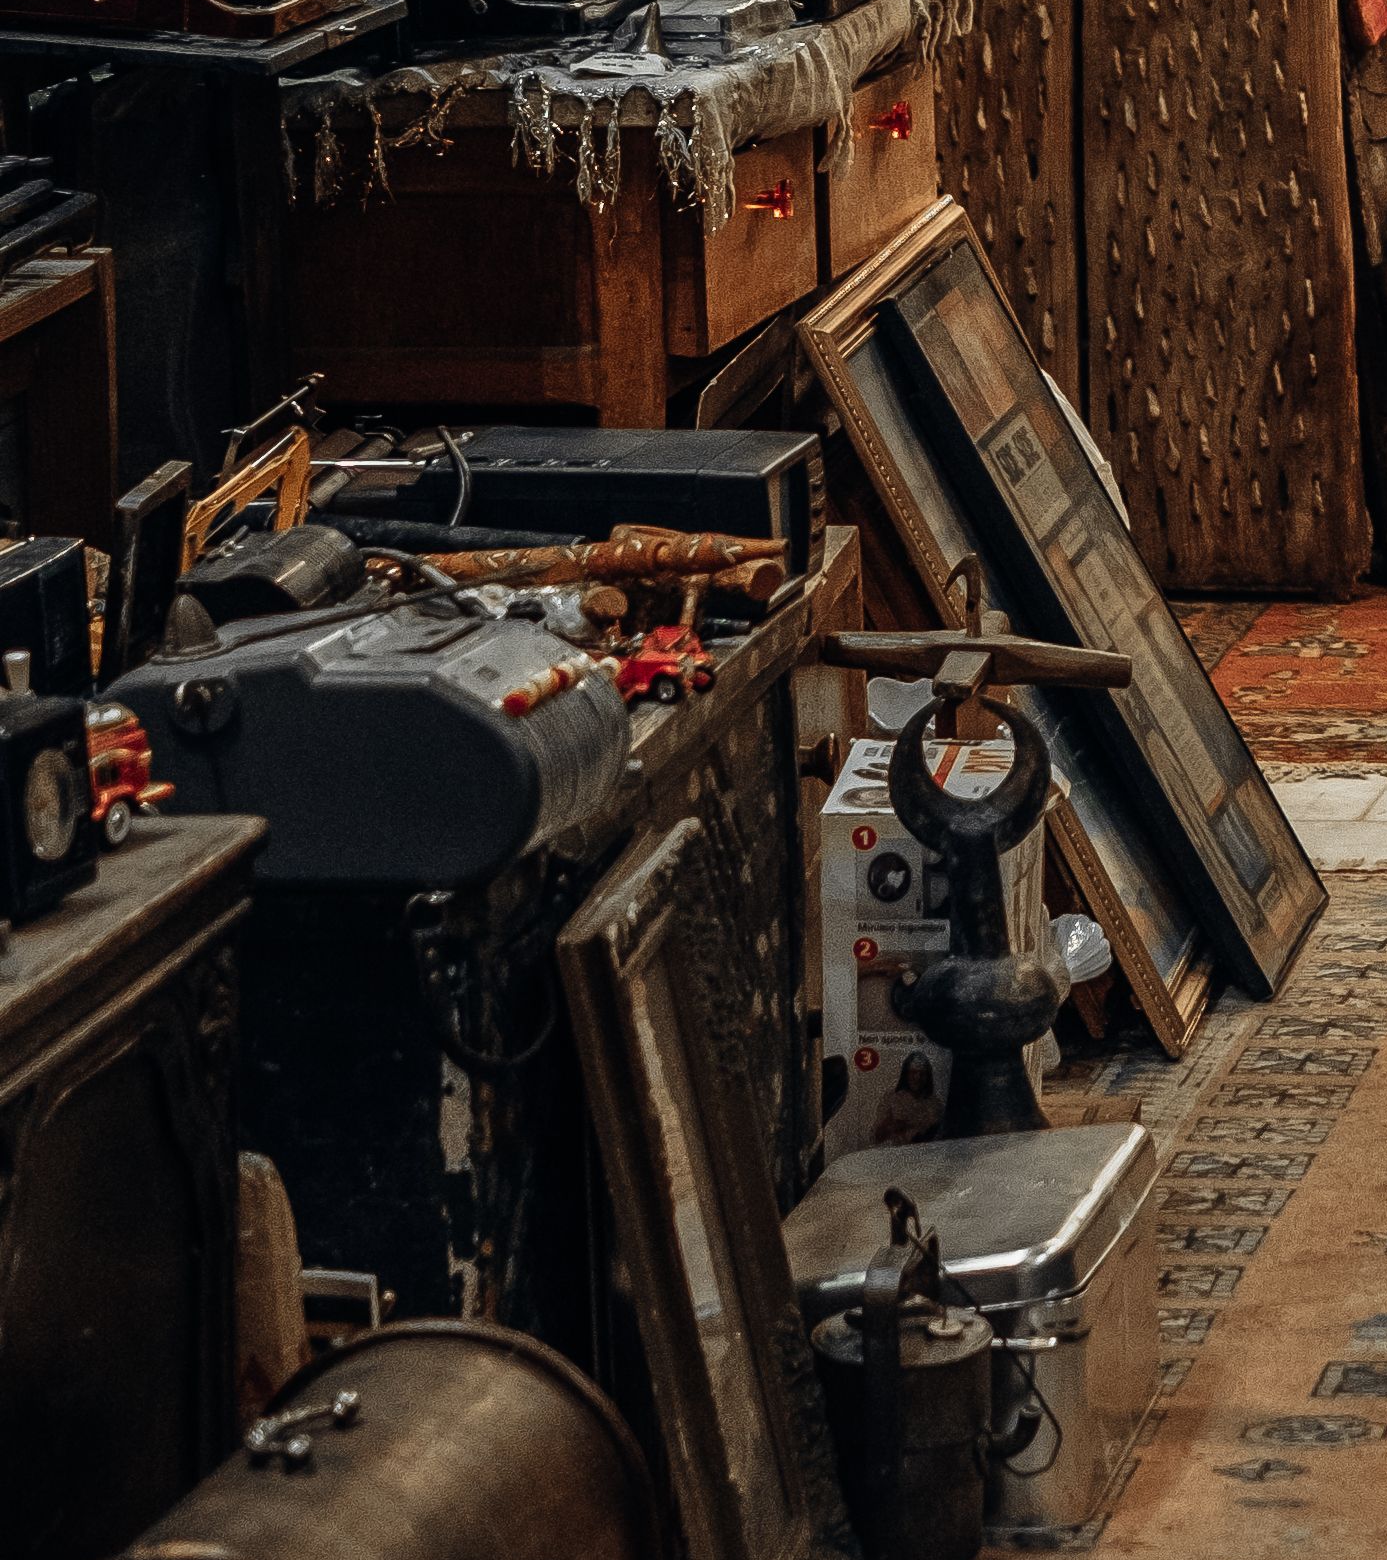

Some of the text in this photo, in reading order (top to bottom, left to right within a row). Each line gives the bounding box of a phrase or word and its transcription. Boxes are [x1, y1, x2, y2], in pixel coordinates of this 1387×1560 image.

[859, 830, 869, 847] 1
[859, 941, 872, 958] 2
[860, 1051, 873, 1068] 3
